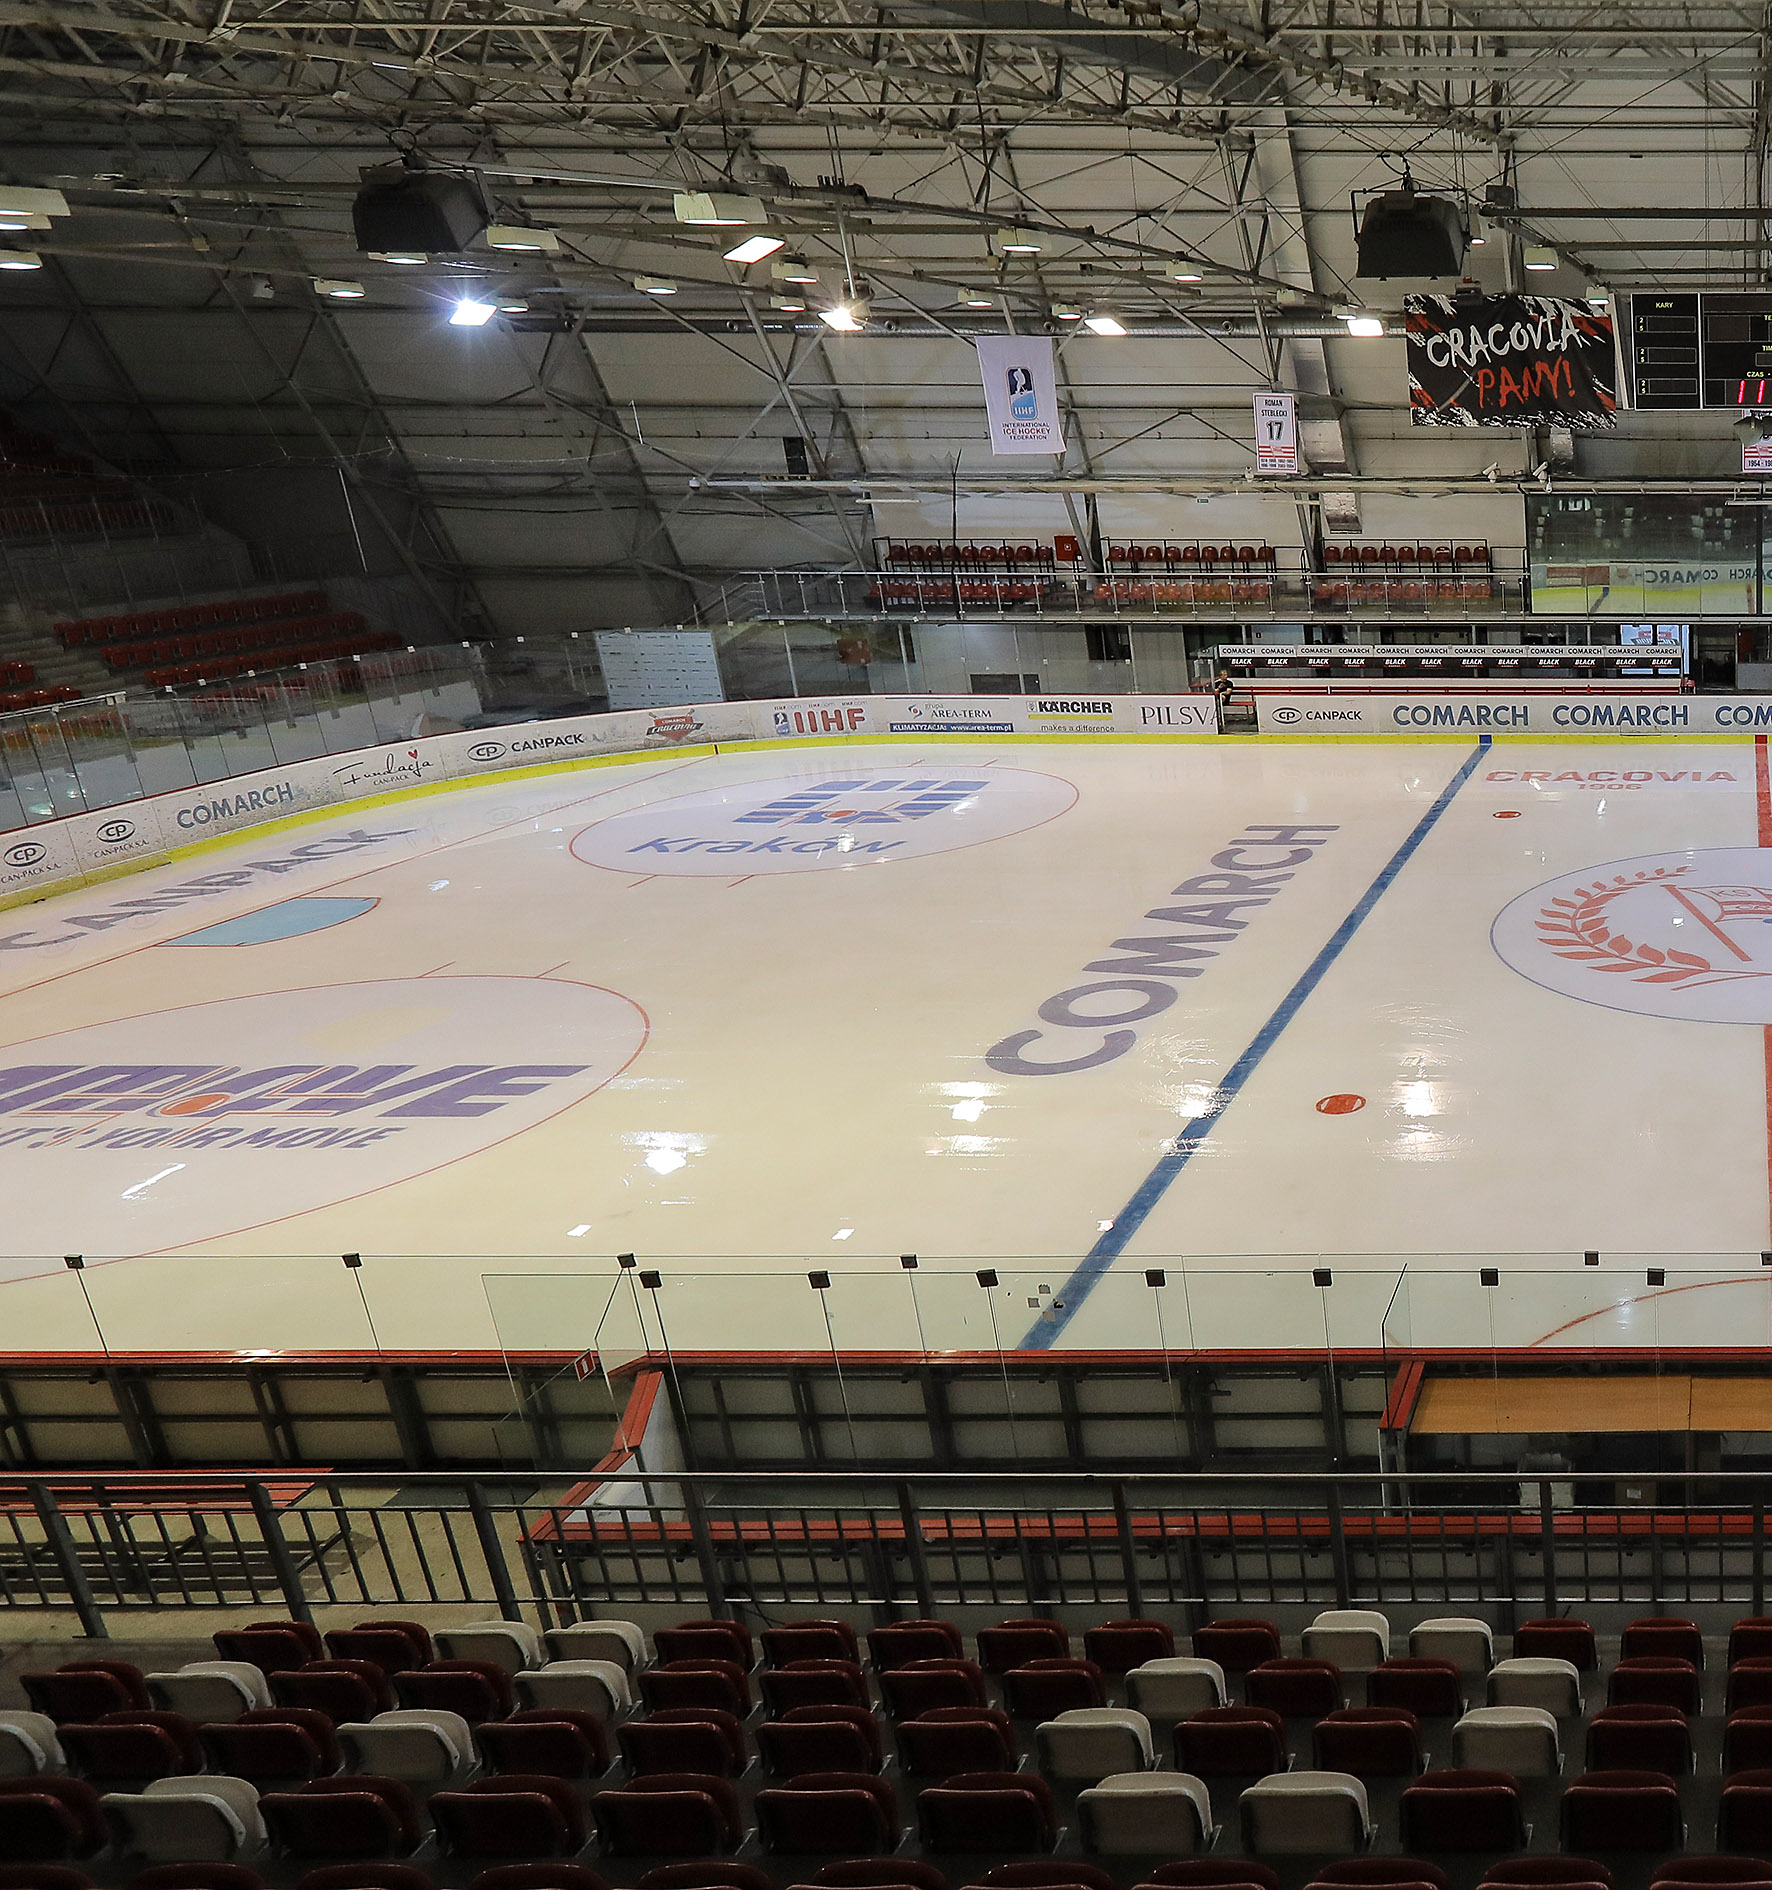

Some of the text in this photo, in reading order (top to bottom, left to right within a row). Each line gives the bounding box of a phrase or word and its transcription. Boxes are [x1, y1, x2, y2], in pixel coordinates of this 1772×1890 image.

[1427, 302, 1583, 368] CRACOVIA
[1477, 354, 1576, 409] PANY!
[1014, 407, 1034, 415] IIHF
[1264, 399, 1283, 407] ROMAN
[1266, 421, 1284, 440] 17
[794, 708, 865, 733] IIHF
[931, 709, 992, 719] AREA-TERM
[1305, 711, 1362, 721] CANPACK
[1392, 705, 1529, 727] COMARCH
[1552, 705, 1689, 727] COMARCH
[950, 723, 1012, 733] www.area-term.pl
[1041, 724, 1067, 732] makes
[1075, 724, 1115, 732] difference
[511, 733, 584, 752] CANPACK
[1485, 771, 1738, 782] CRACOVIA
[177, 782, 294, 829] COMARCH
[94, 843, 134, 859] CAN-PACK
[626, 835, 907, 854] Kraków
[1, 867, 45, 884] CAN-PACK
[0, 829, 419, 950] CANPACK
[1710, 889, 1751, 898] KS
[985, 825, 1341, 1076] COMARCH
[220, 1127, 408, 1149] MOVE
